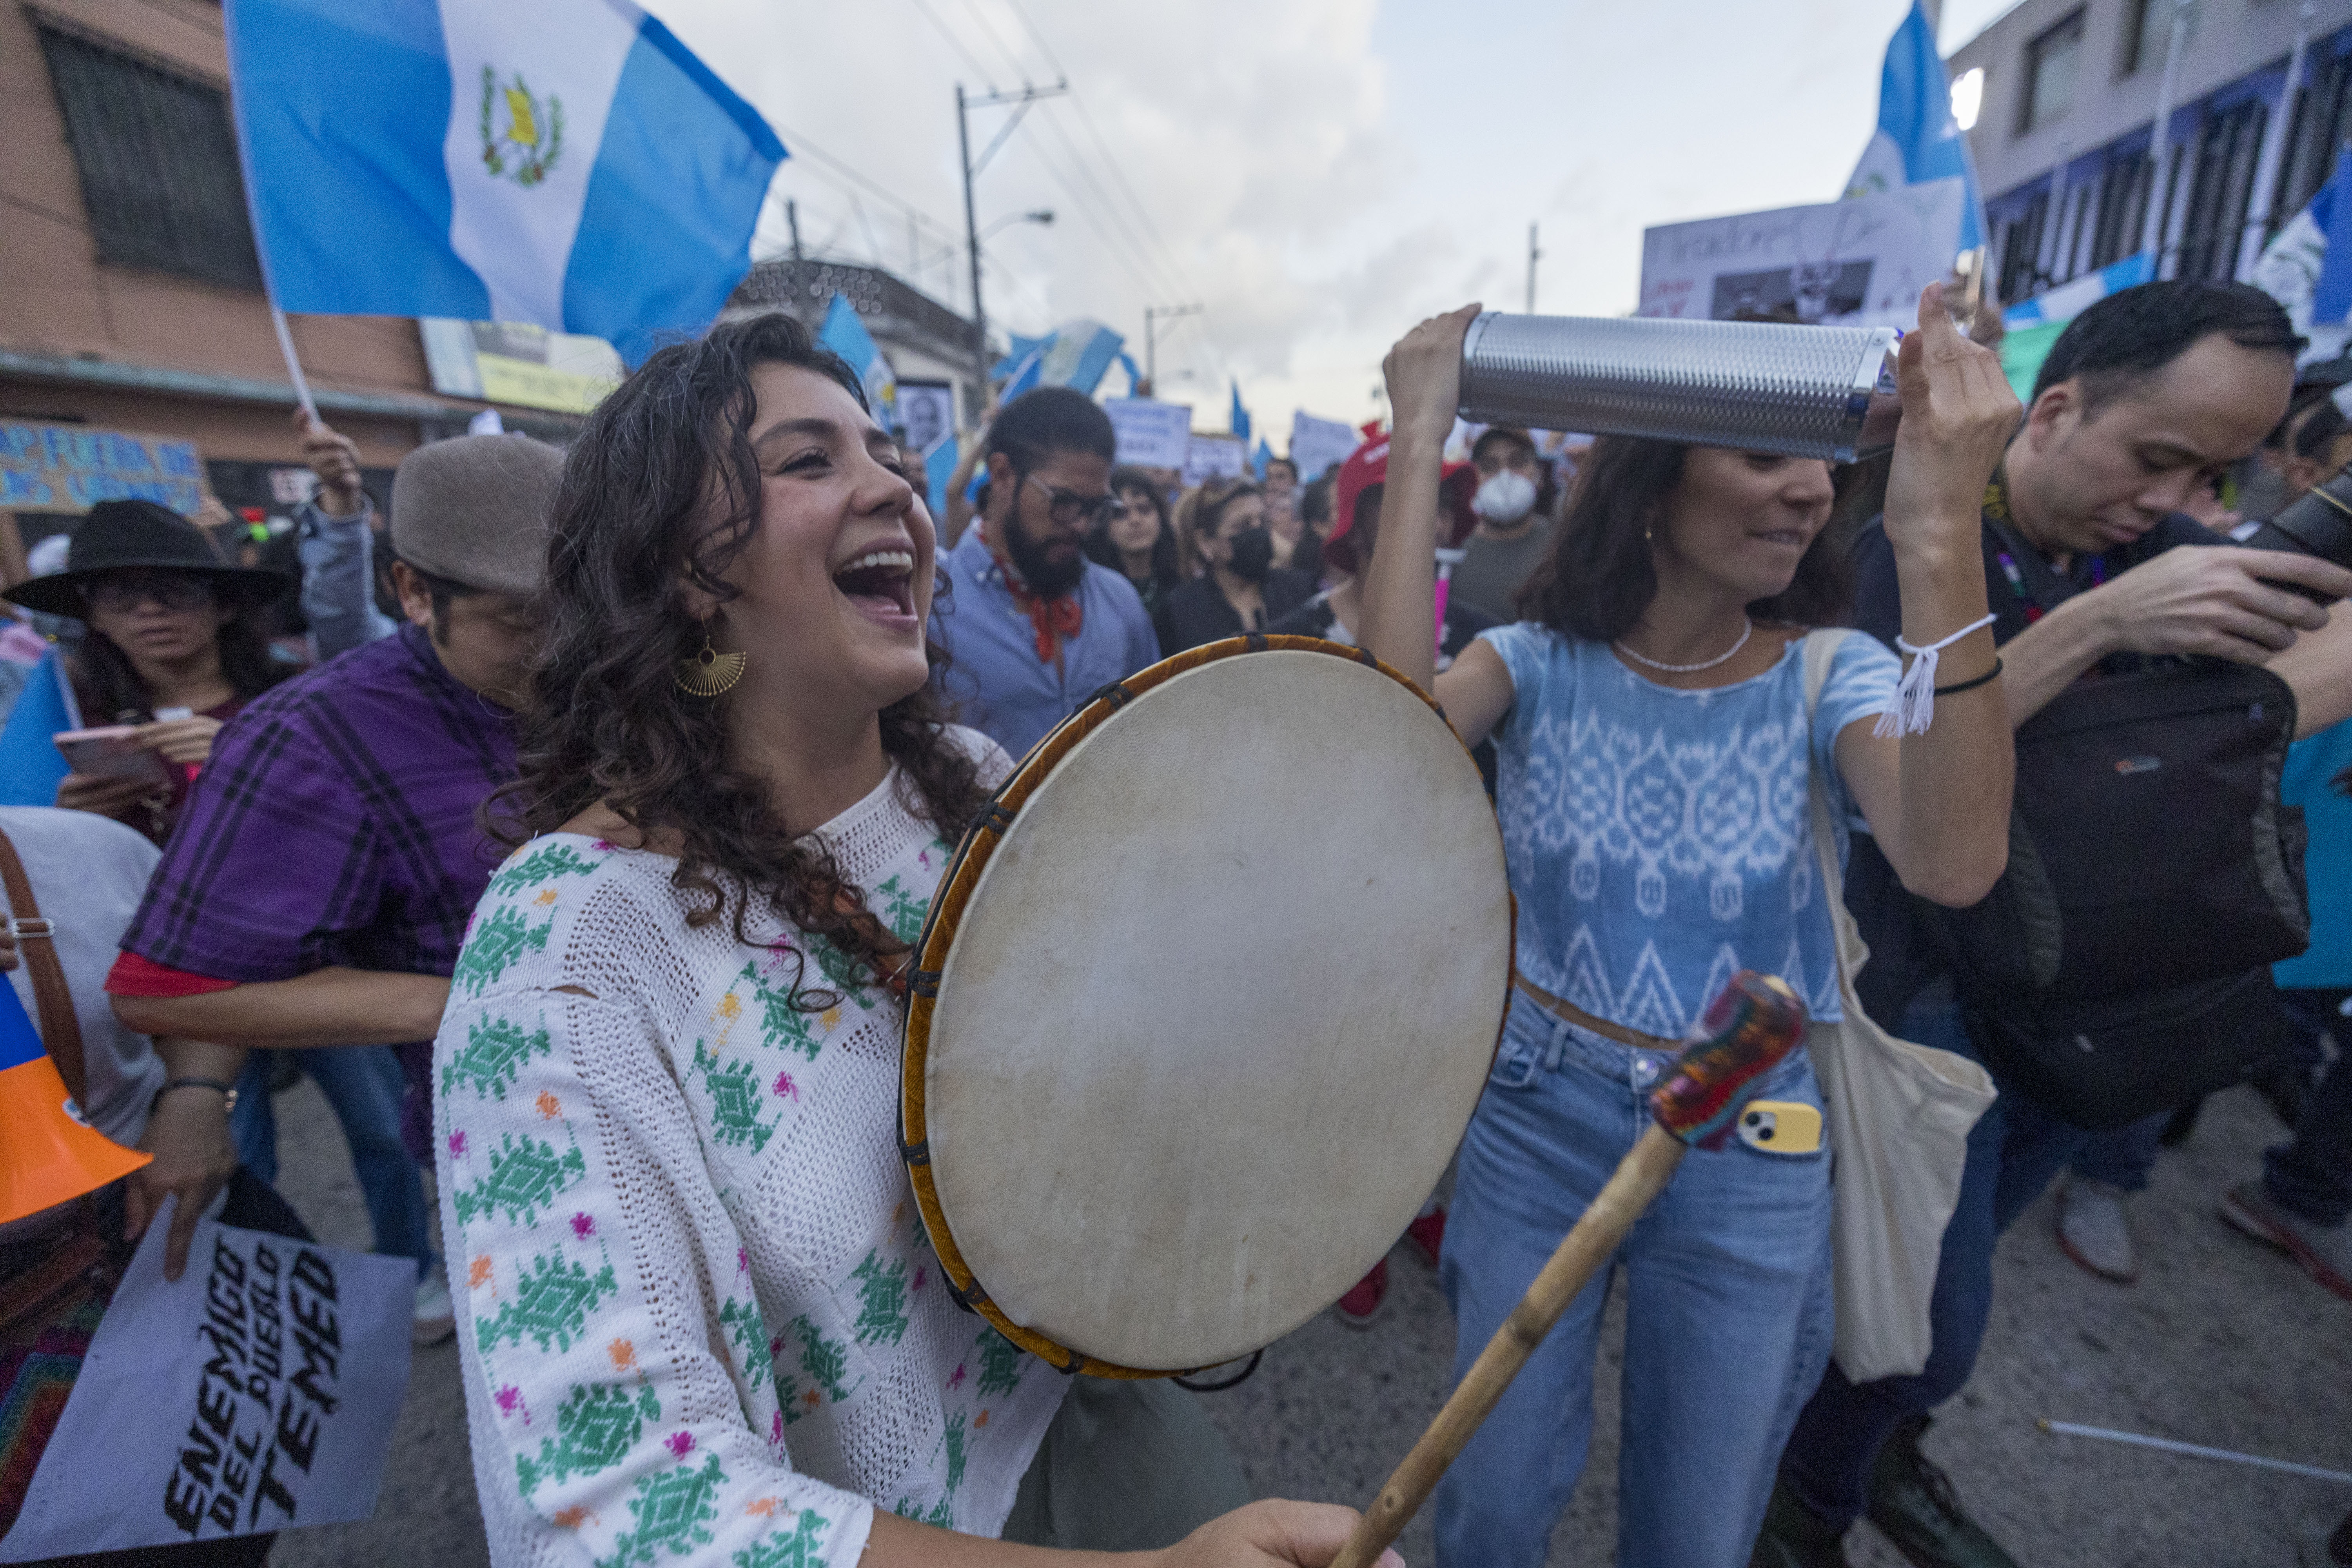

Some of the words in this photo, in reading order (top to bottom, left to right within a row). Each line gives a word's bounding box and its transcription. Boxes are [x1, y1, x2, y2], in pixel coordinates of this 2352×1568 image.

[164, 1234, 247, 1537] ENEMIGO
[208, 1432, 261, 1532] DEL
[247, 1242, 281, 1414] PUEBLO
[249, 1250, 342, 1532] TEMED
